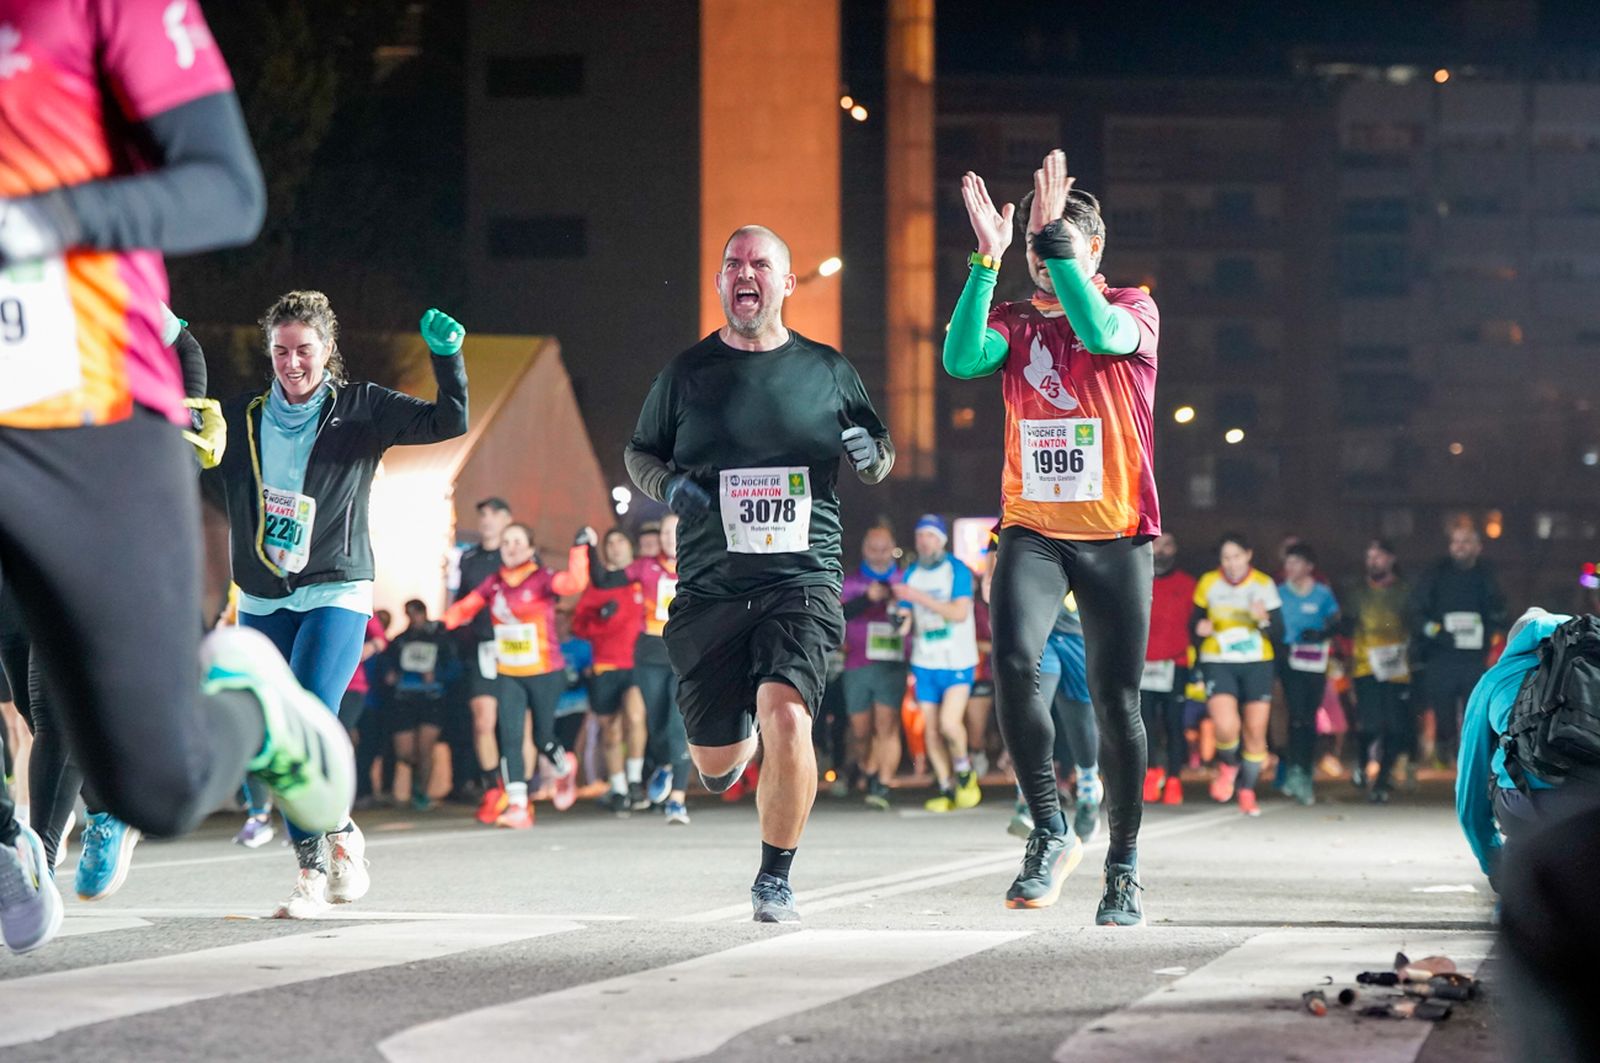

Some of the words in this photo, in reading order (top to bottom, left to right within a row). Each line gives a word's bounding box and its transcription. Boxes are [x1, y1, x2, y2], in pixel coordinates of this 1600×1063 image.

[1040, 375, 1060, 399] 43
[1056, 428, 1067, 437] DE
[1032, 449, 1084, 474] 1996
[731, 488, 749, 498] SAN
[741, 478, 769, 487] NOCHE
[770, 477, 781, 486] DE
[740, 499, 796, 523] 3078
[266, 514, 303, 546] 220
